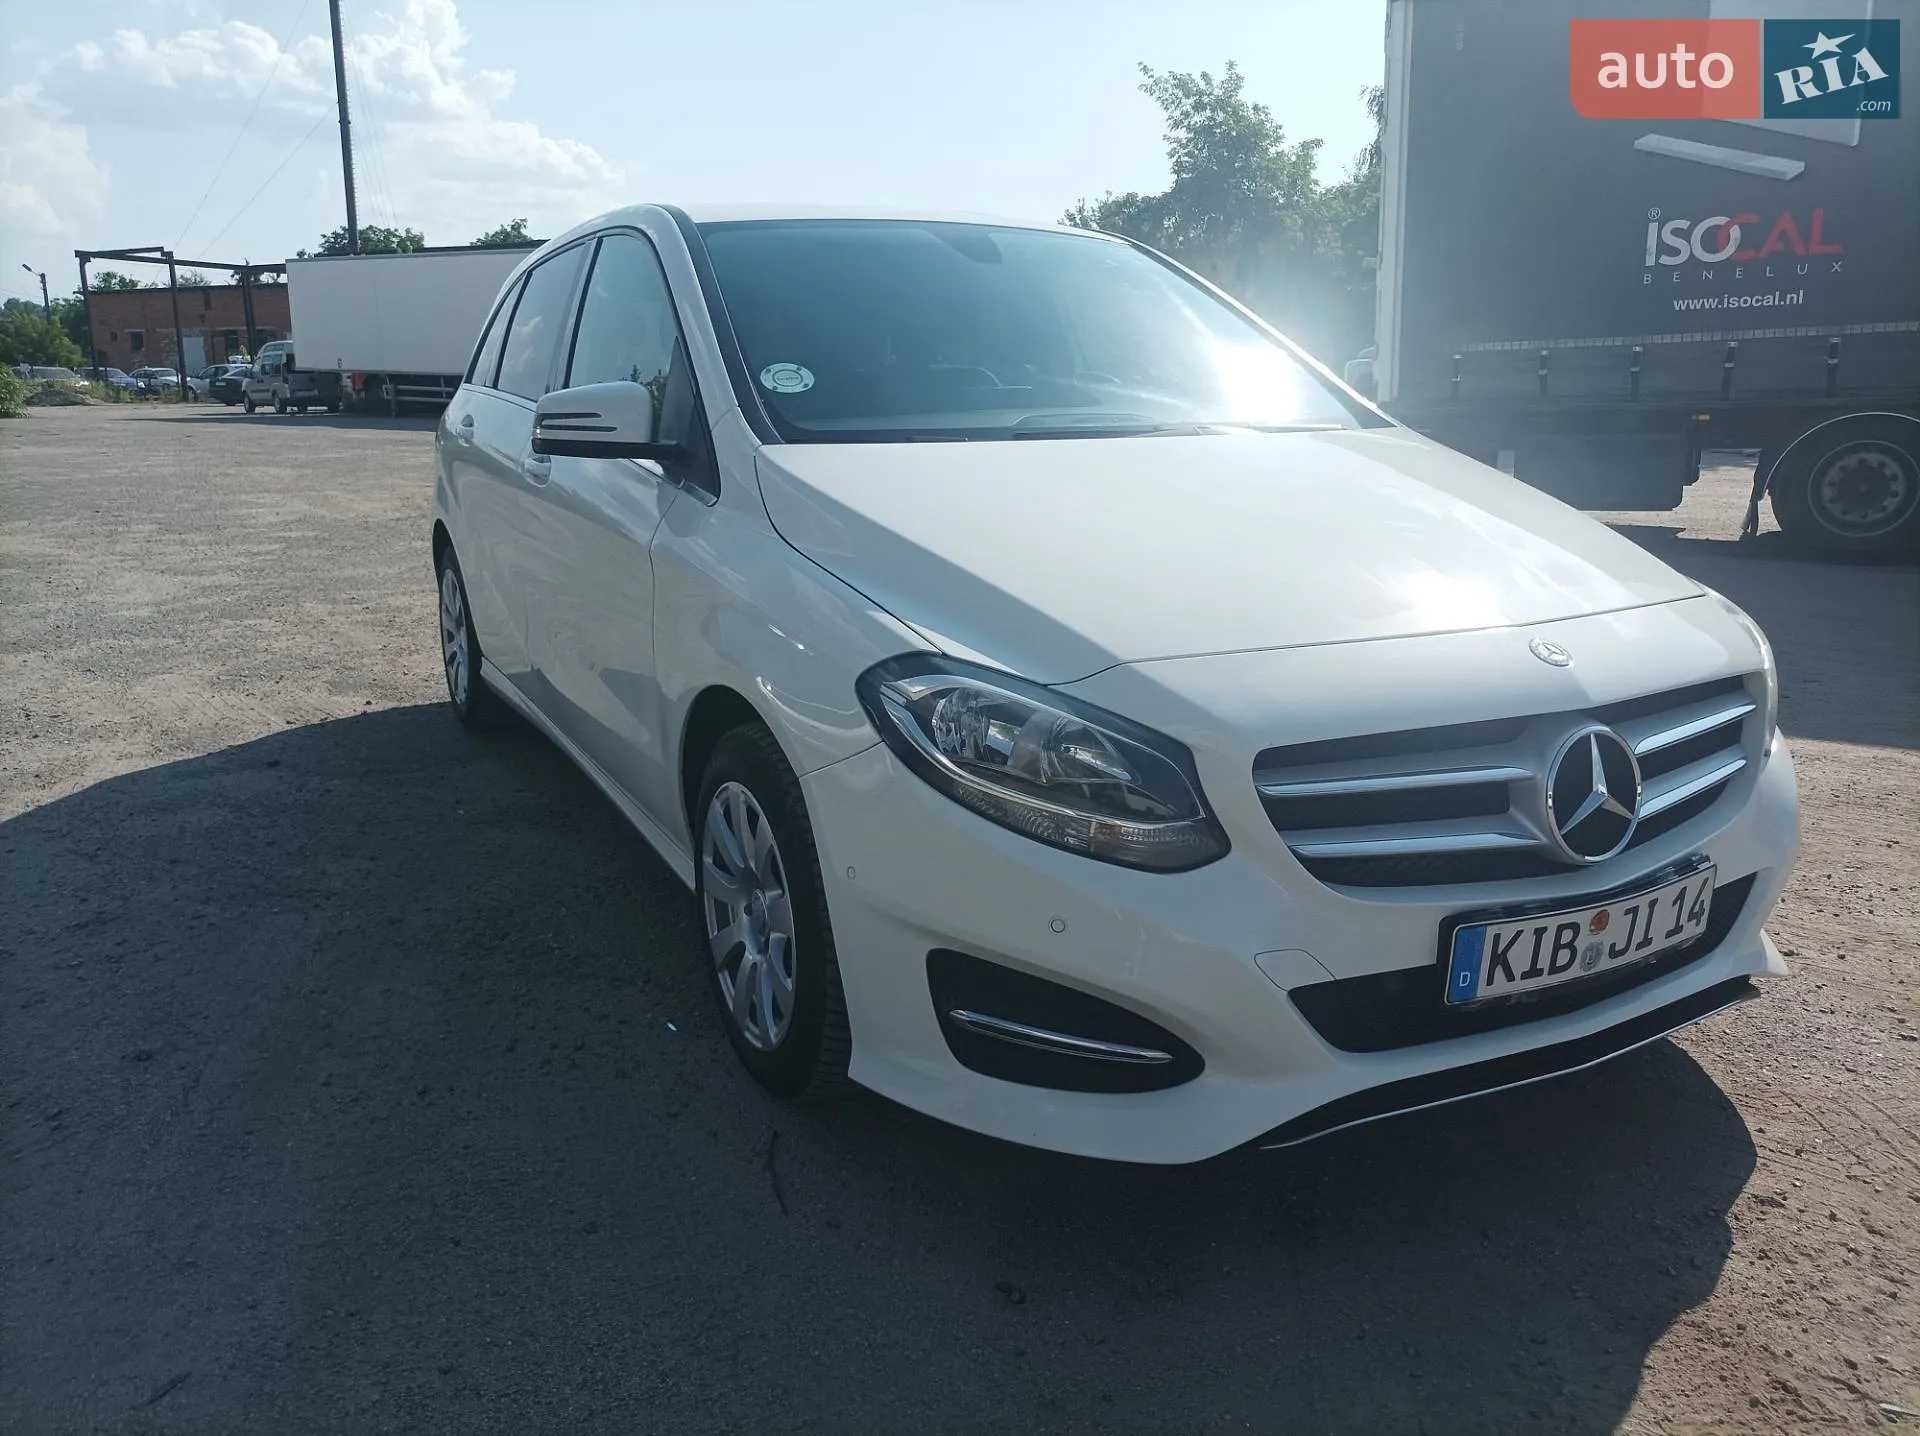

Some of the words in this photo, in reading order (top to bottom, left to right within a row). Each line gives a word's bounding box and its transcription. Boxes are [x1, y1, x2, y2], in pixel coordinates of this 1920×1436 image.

[1643, 261, 1843, 285] BENELUX
[1673, 289, 1804, 311] www.isocal.nl
[1486, 921, 1581, 987] KIB
[1608, 898, 1658, 959] JI
[1665, 877, 1706, 939] 14
[1459, 971, 1471, 987] D
